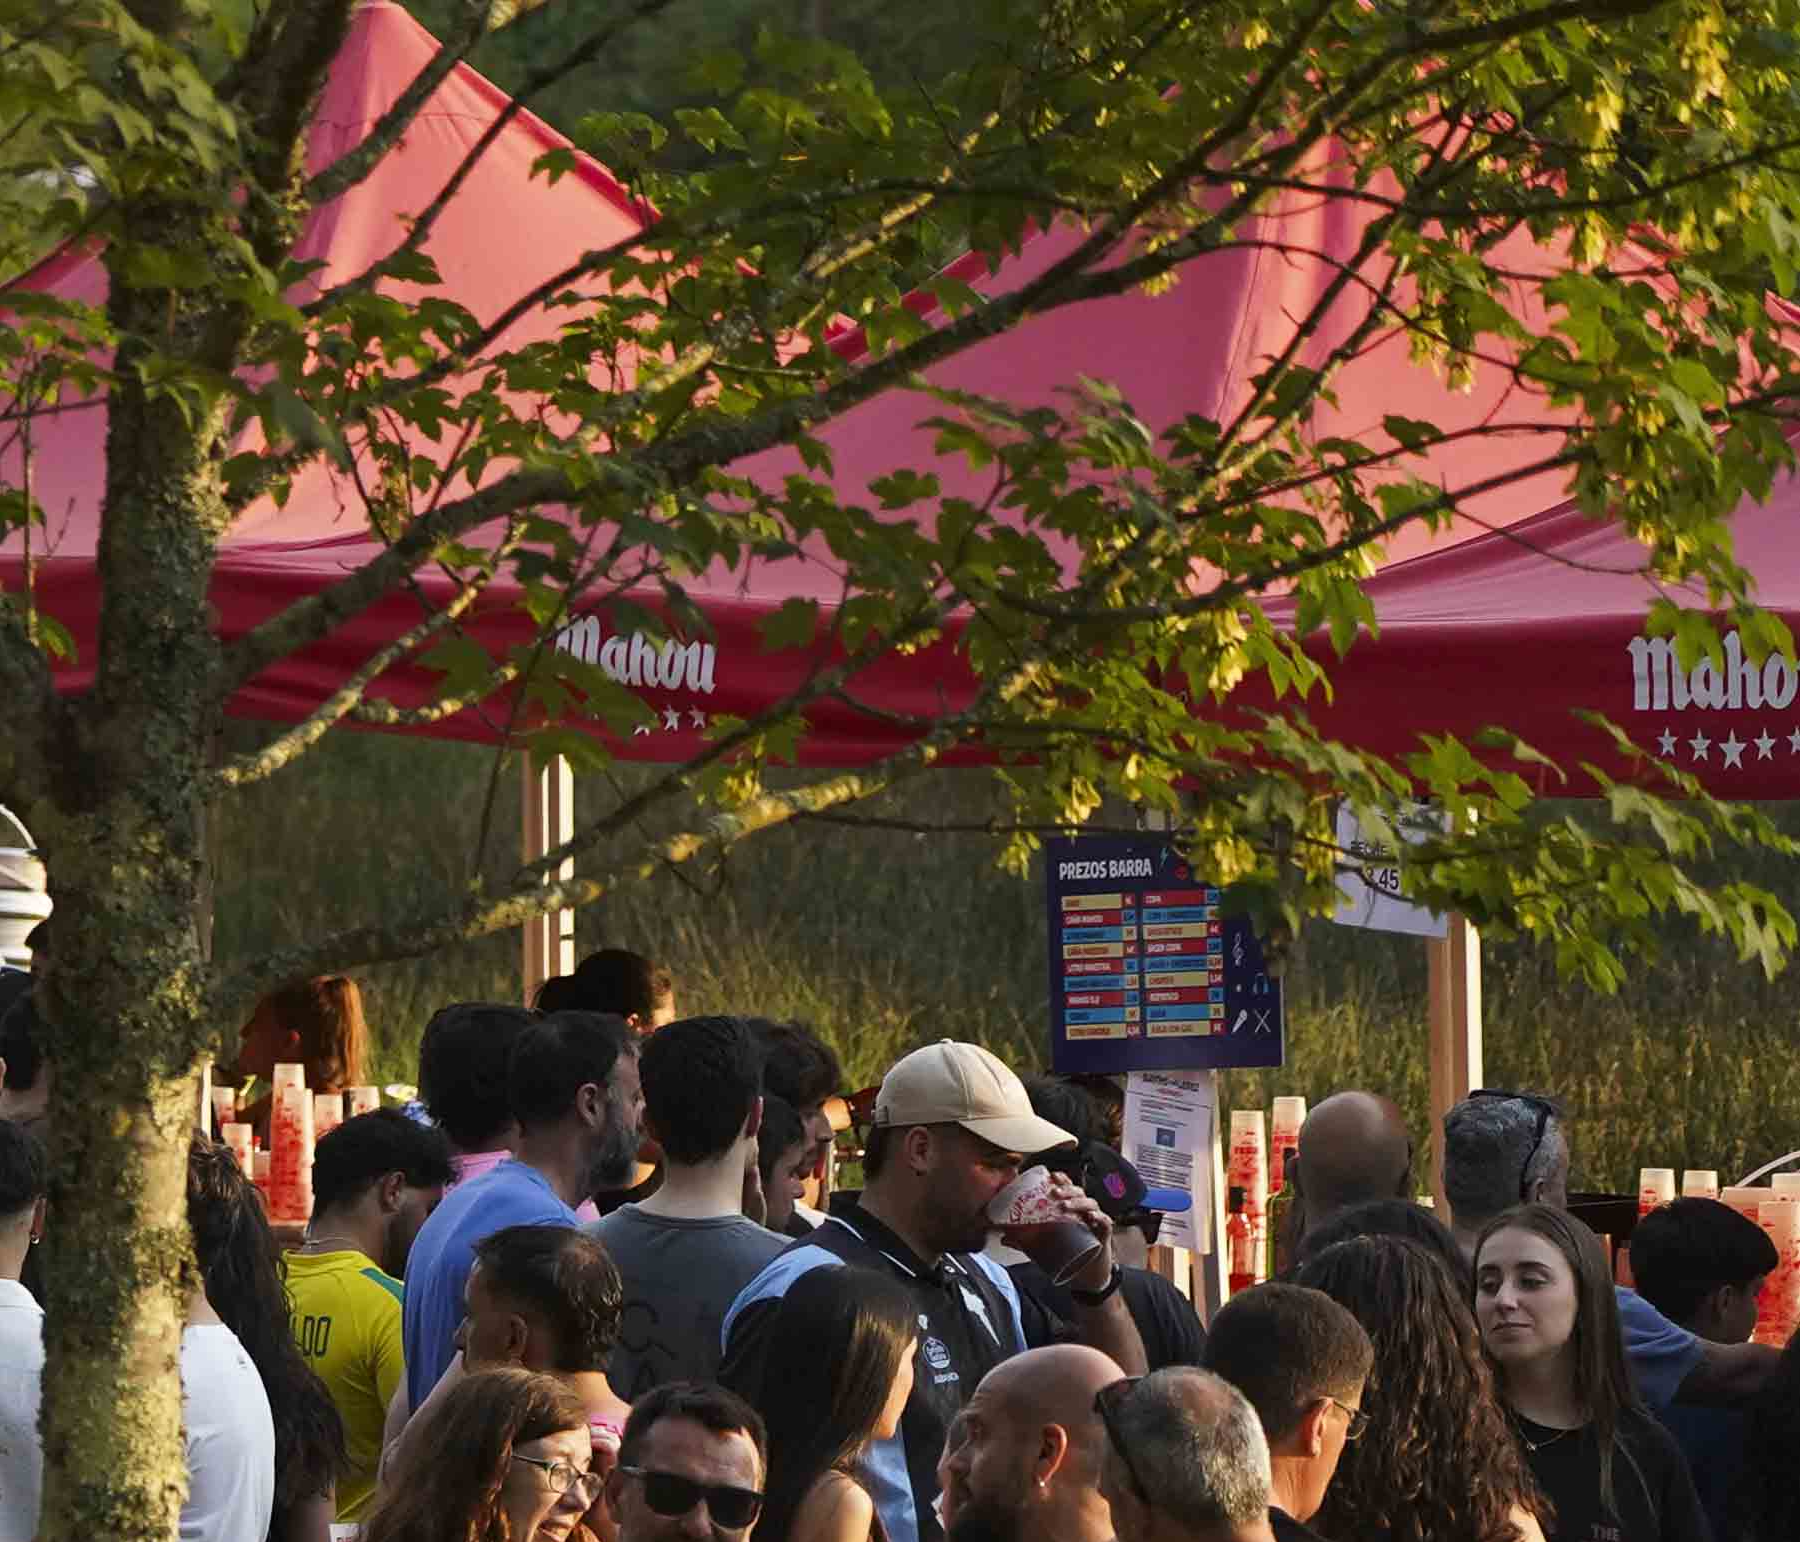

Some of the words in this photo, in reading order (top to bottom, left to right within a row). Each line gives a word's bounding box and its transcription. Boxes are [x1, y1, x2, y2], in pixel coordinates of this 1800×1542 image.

[1625, 629, 1800, 711] Maho
[1059, 860, 1107, 881] PREZOS
[1109, 858, 1153, 878] BARRA
